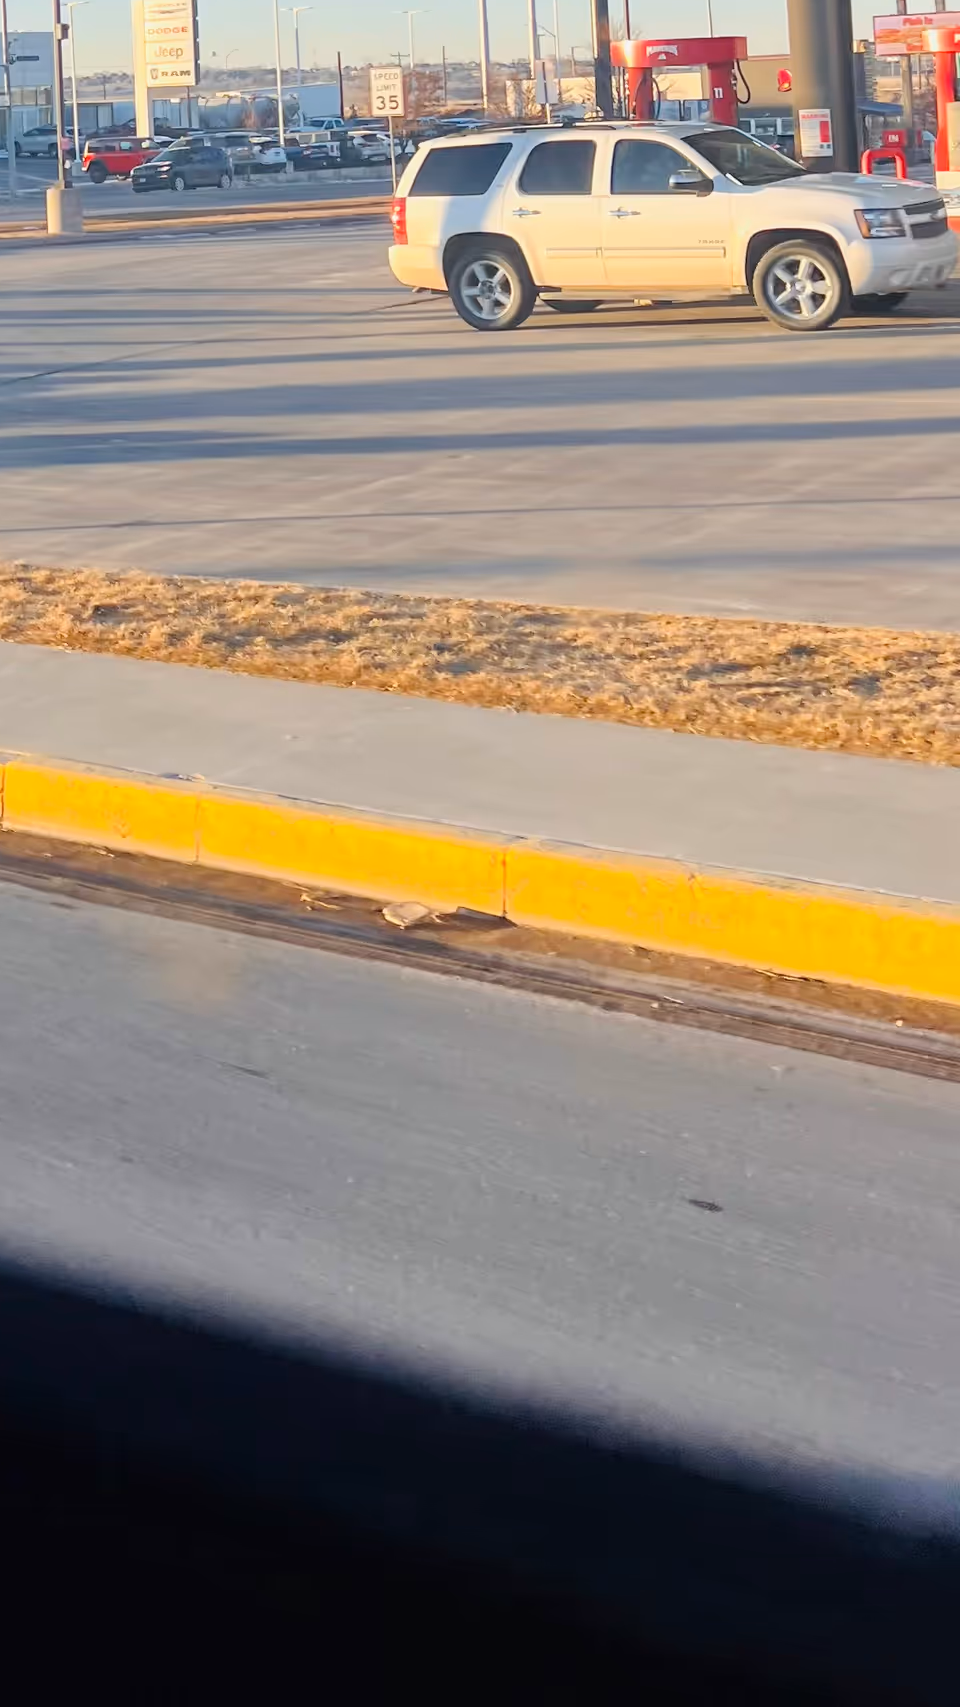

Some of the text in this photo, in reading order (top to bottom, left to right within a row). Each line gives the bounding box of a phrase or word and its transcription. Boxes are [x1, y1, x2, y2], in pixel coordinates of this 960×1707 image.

[147, 26, 189, 35] DODGE
[154, 46, 184, 59] Jeep
[376, 83, 397, 92] LIMIT
[376, 95, 400, 110] 35
